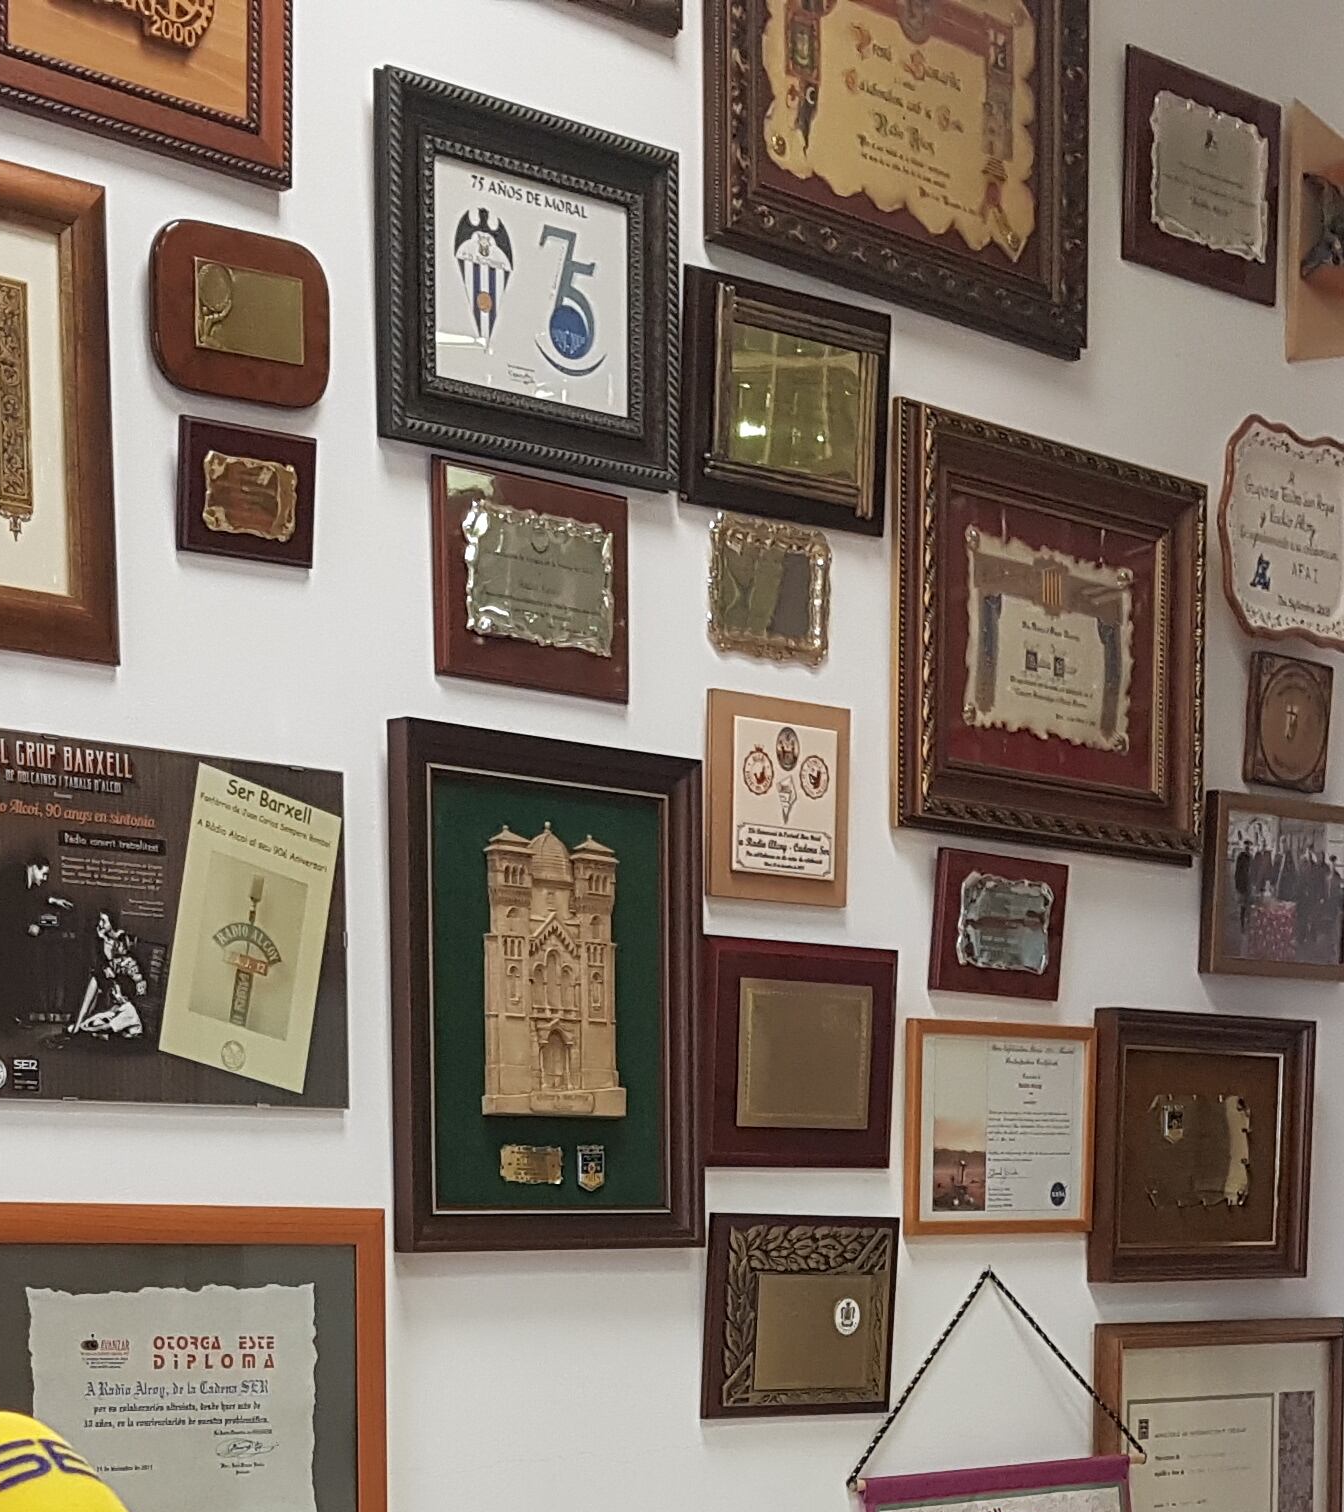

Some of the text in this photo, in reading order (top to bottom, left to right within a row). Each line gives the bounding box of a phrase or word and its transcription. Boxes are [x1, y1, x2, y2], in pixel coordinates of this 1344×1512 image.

[151, 16, 196, 48] 2000
[470, 175, 589, 220] 75 AÑOS DE MORAL
[15, 739, 57, 770] GRUP
[62, 745, 134, 780] BARXELL
[45, 803, 63, 819] 90
[64, 809, 93, 825] anys
[94, 813, 107, 824] en
[226, 779, 313, 826] Ser Barxell
[216, 922, 250, 946] RADIO
[13, 1059, 38, 1071] SER
[152, 1335, 275, 1351] OTORGA ESTE
[98, 1380, 132, 1398] Radio
[172, 1381, 185, 1396] de
[186, 1381, 197, 1395] la
[199, 1380, 238, 1396] Cadena
